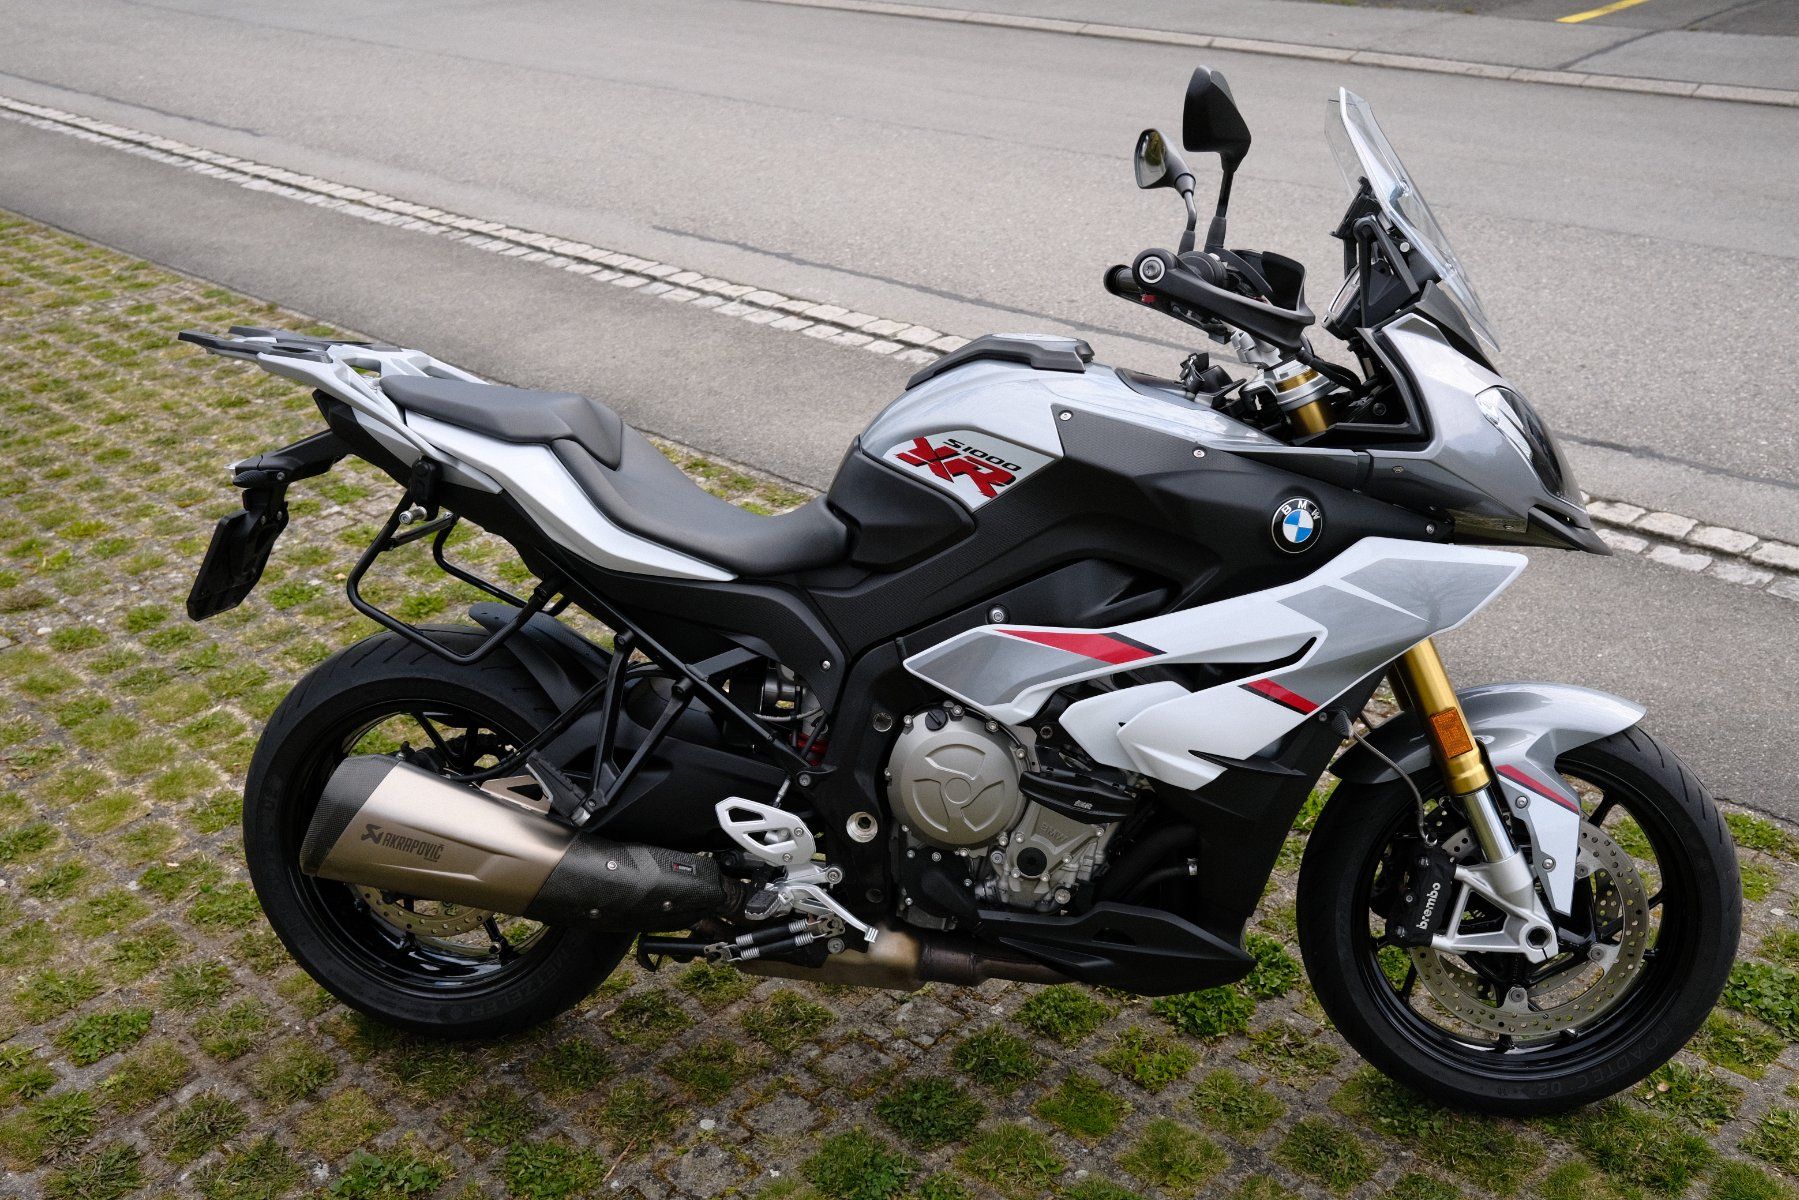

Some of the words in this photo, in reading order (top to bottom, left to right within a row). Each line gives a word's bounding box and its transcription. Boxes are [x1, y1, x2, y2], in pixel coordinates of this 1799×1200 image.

[893, 436, 1017, 499] XR
[1281, 500, 1320, 520] BMW
[1416, 882, 1441, 930] brembo
